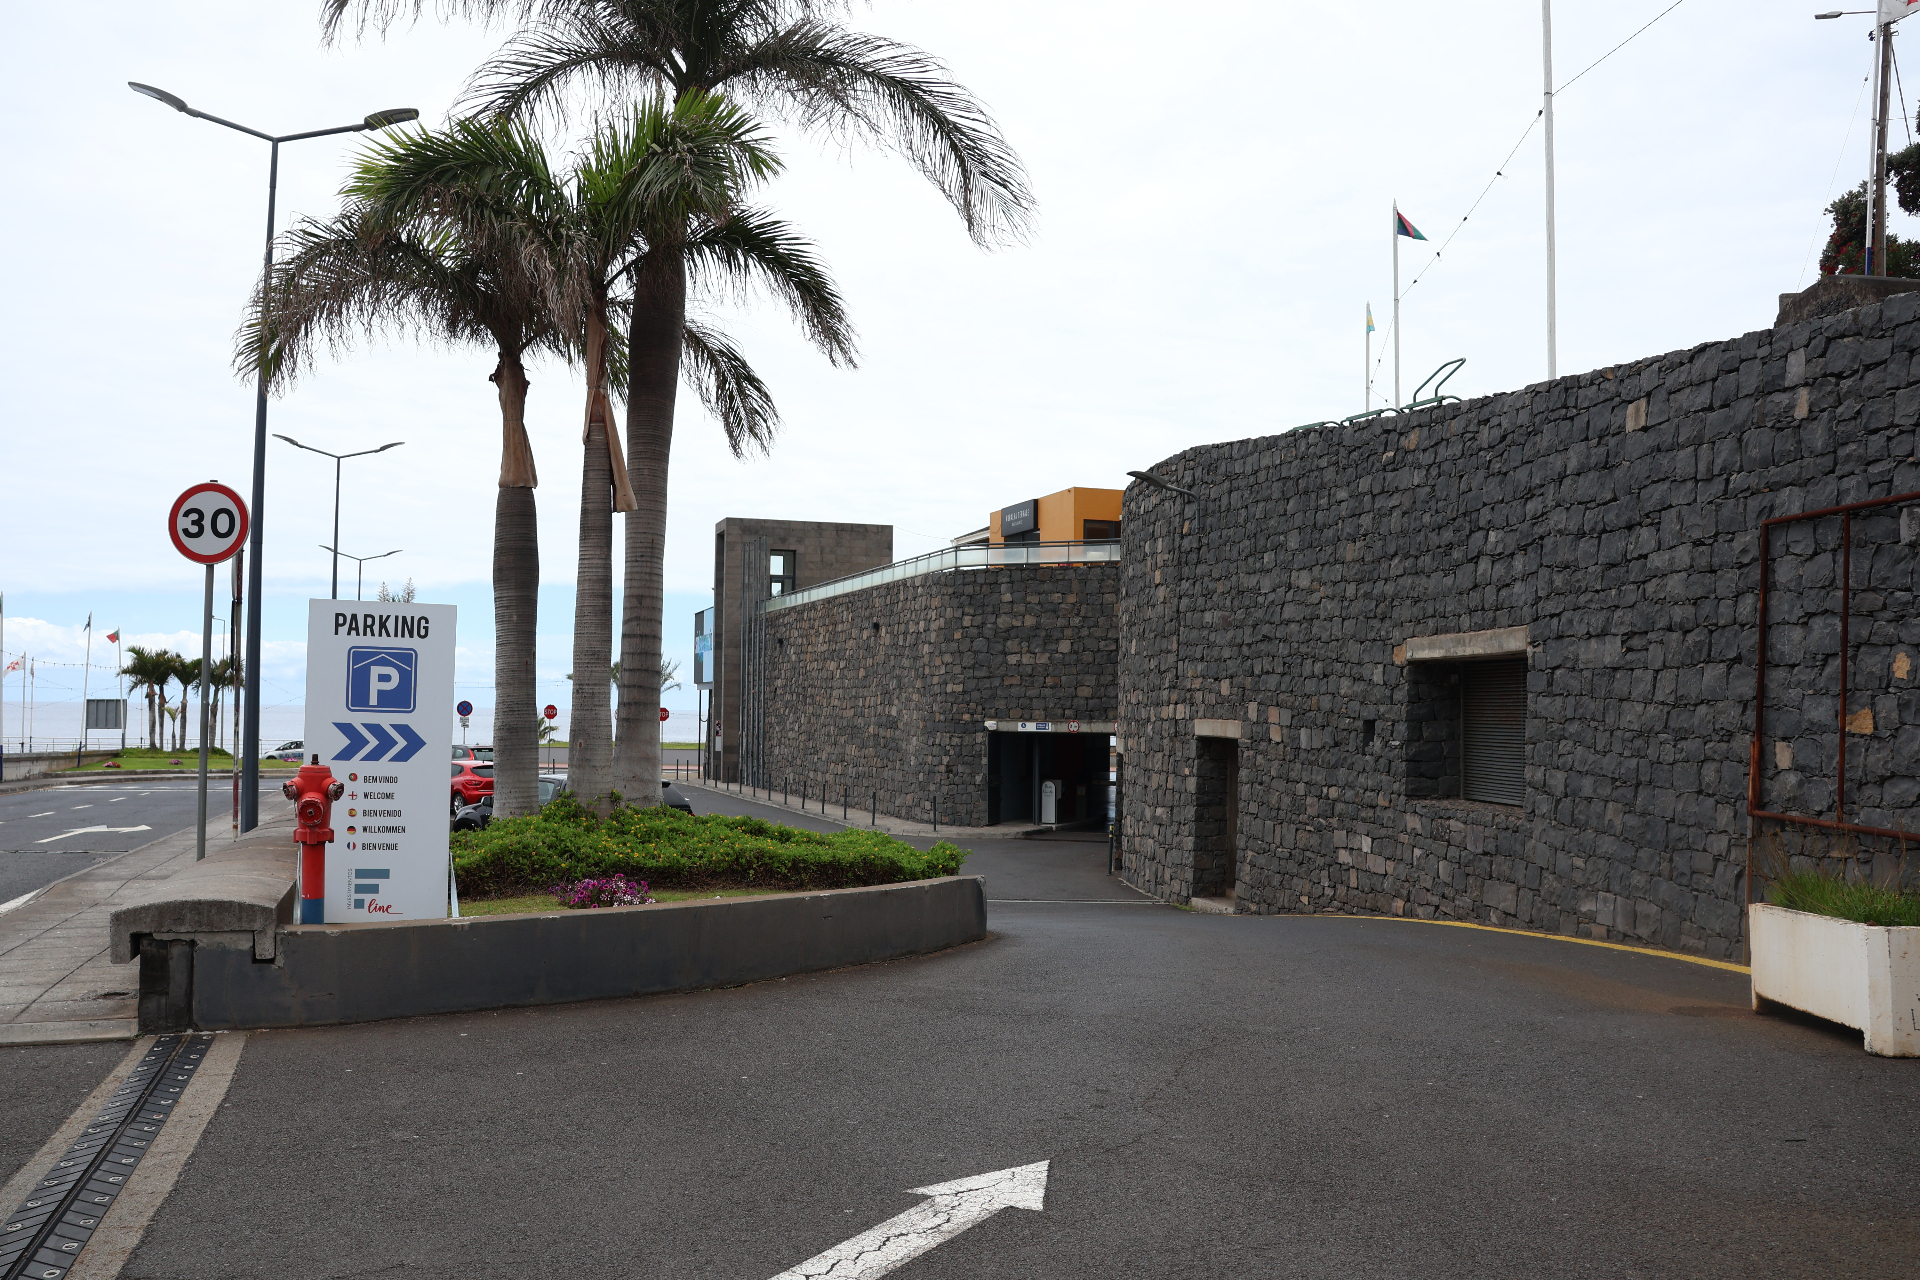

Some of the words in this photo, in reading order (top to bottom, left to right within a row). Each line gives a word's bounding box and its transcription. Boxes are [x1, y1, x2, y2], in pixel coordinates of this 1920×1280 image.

[181, 507, 236, 539] 30
[334, 612, 430, 640] PARKING
[368, 665, 400, 706] P
[363, 775, 378, 784] BEM
[378, 775, 399, 784] VINDO
[363, 791, 395, 800] WELCOME
[362, 825, 406, 834] WILLKOMMEN
[367, 898, 403, 914] line
